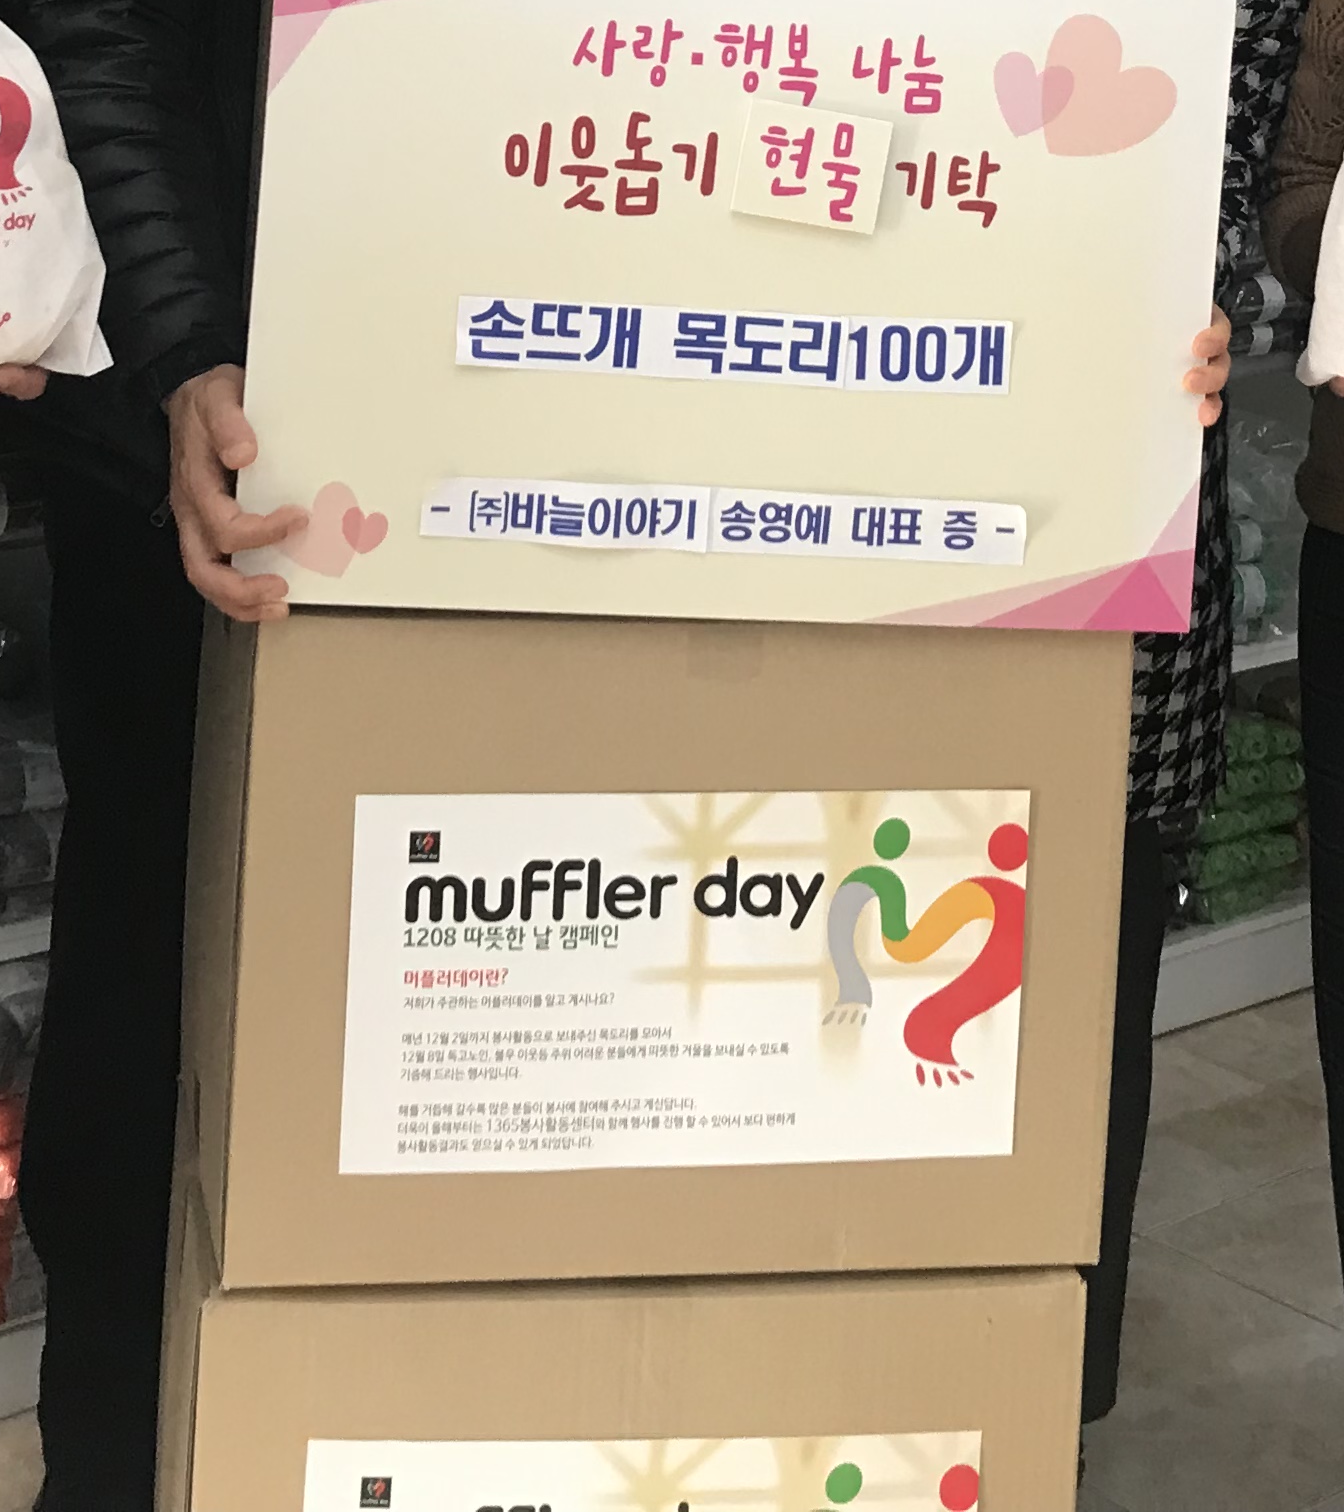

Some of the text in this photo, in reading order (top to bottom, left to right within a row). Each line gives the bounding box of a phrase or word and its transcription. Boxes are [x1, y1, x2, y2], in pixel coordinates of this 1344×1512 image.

[850, 34, 945, 116] 나눔
[502, 111, 1002, 229] 이웃돕기 현물 기탁
[3, 212, 36, 231] day
[466, 299, 1006, 388] 손뜨개 목도리100개
[718, 493, 833, 548] 송영예
[850, 503, 924, 550] 대표
[941, 506, 978, 552] 증
[404, 856, 825, 930] muffler day
[403, 924, 619, 951] 1208 따뜻한 날 캠페인
[403, 968, 510, 989] 머플러데이란?
[404, 995, 435, 1010] 저희가
[545, 993, 566, 1007] 알고
[568, 992, 616, 1007] 계시나요?
